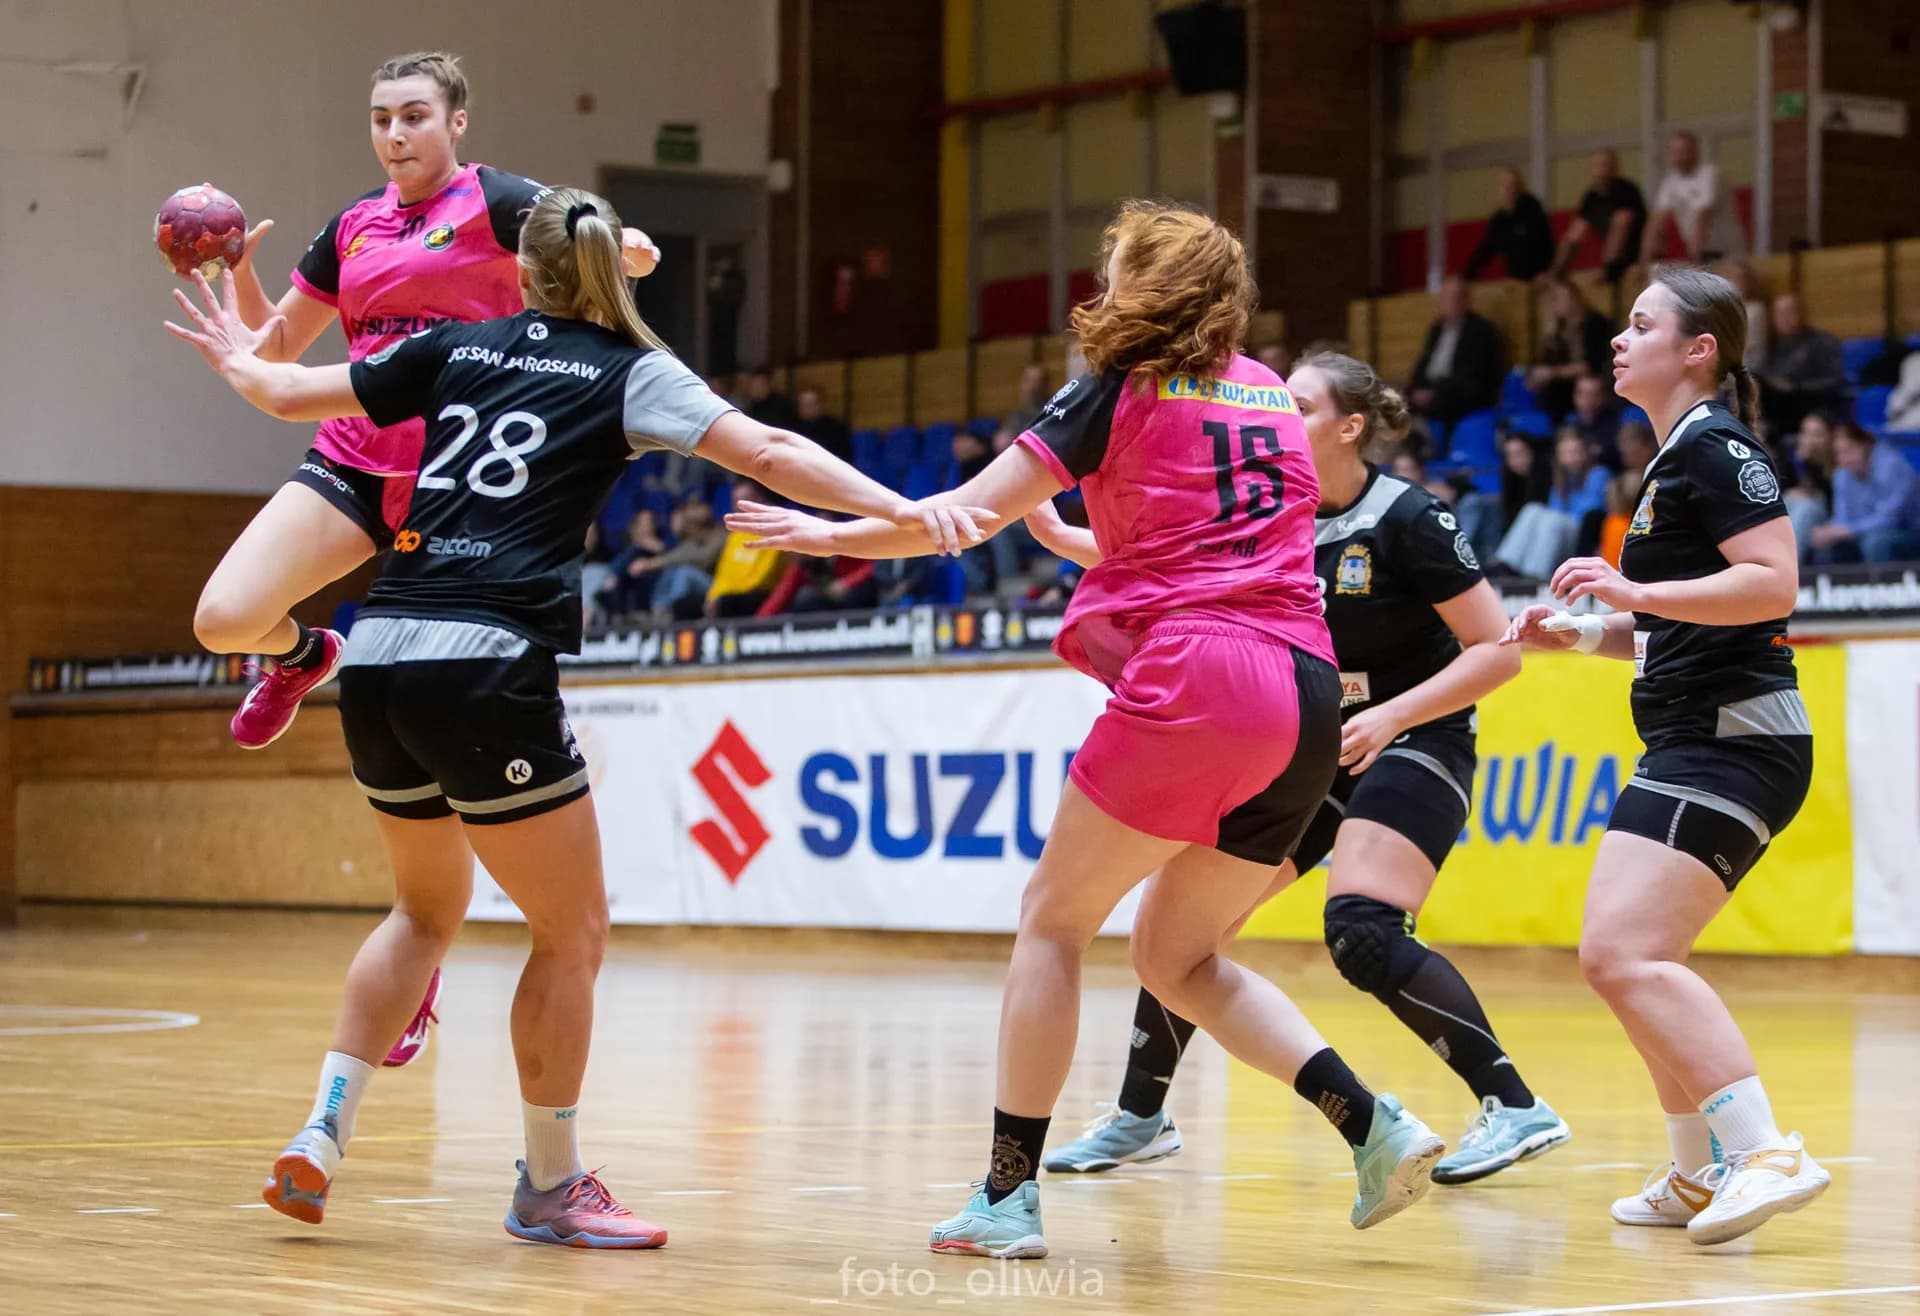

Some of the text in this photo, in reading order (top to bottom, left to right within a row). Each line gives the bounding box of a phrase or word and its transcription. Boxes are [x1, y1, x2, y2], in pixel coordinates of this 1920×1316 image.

[503, 355, 602, 382] JAROSŁAW
[417, 403, 548, 499] 28
[799, 750, 1077, 861] SUZU
